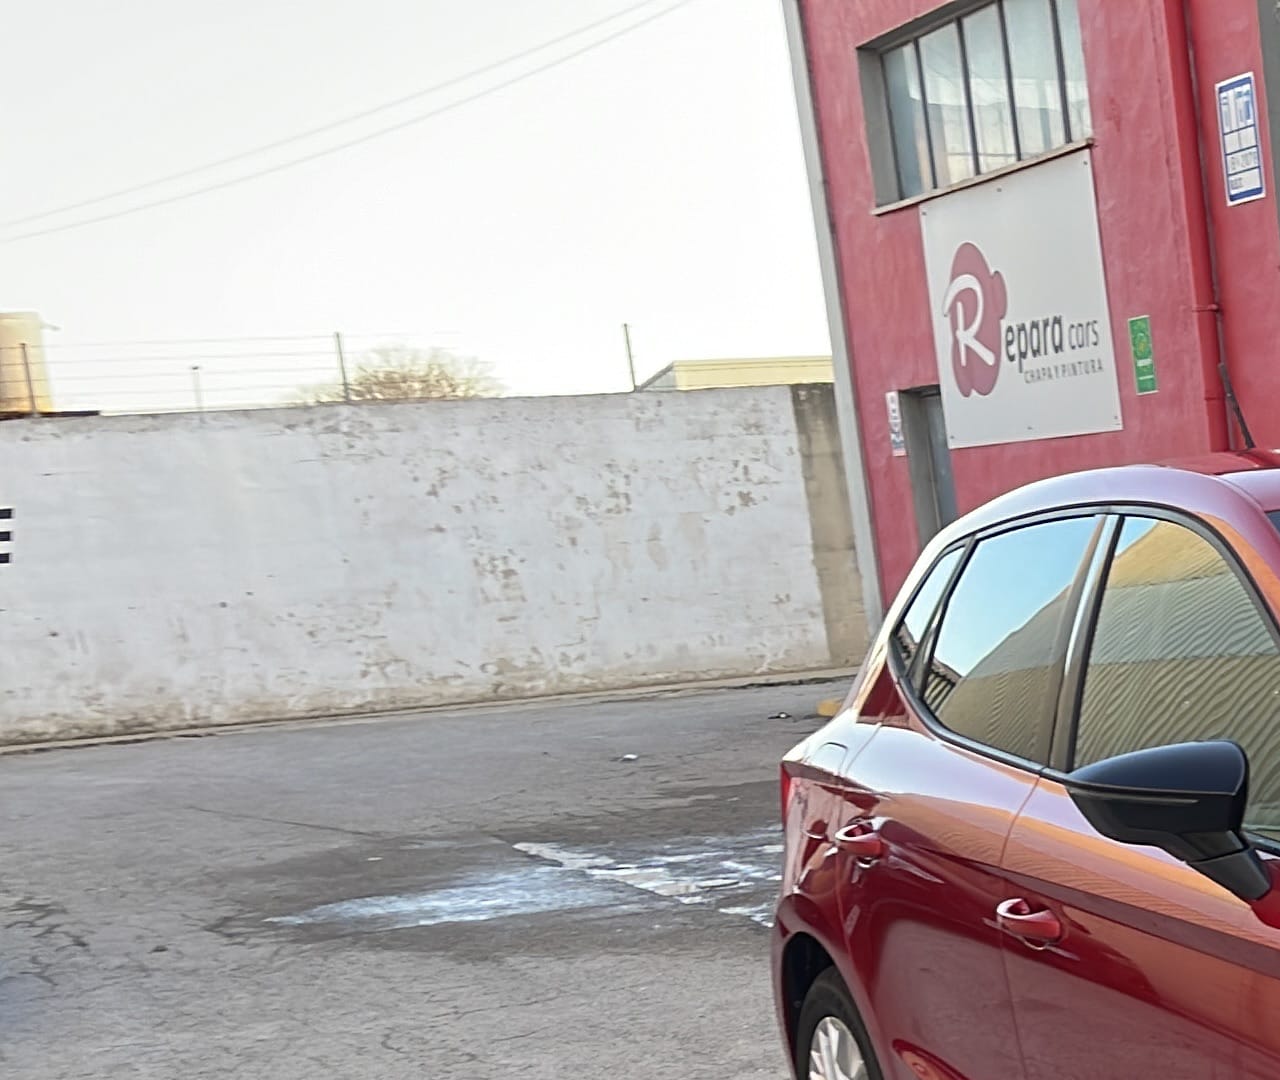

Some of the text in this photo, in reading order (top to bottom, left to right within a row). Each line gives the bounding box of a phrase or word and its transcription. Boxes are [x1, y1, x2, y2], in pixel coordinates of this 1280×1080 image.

[943, 273, 1099, 374] Repara cars
[1061, 358, 1104, 378] PINTURA
